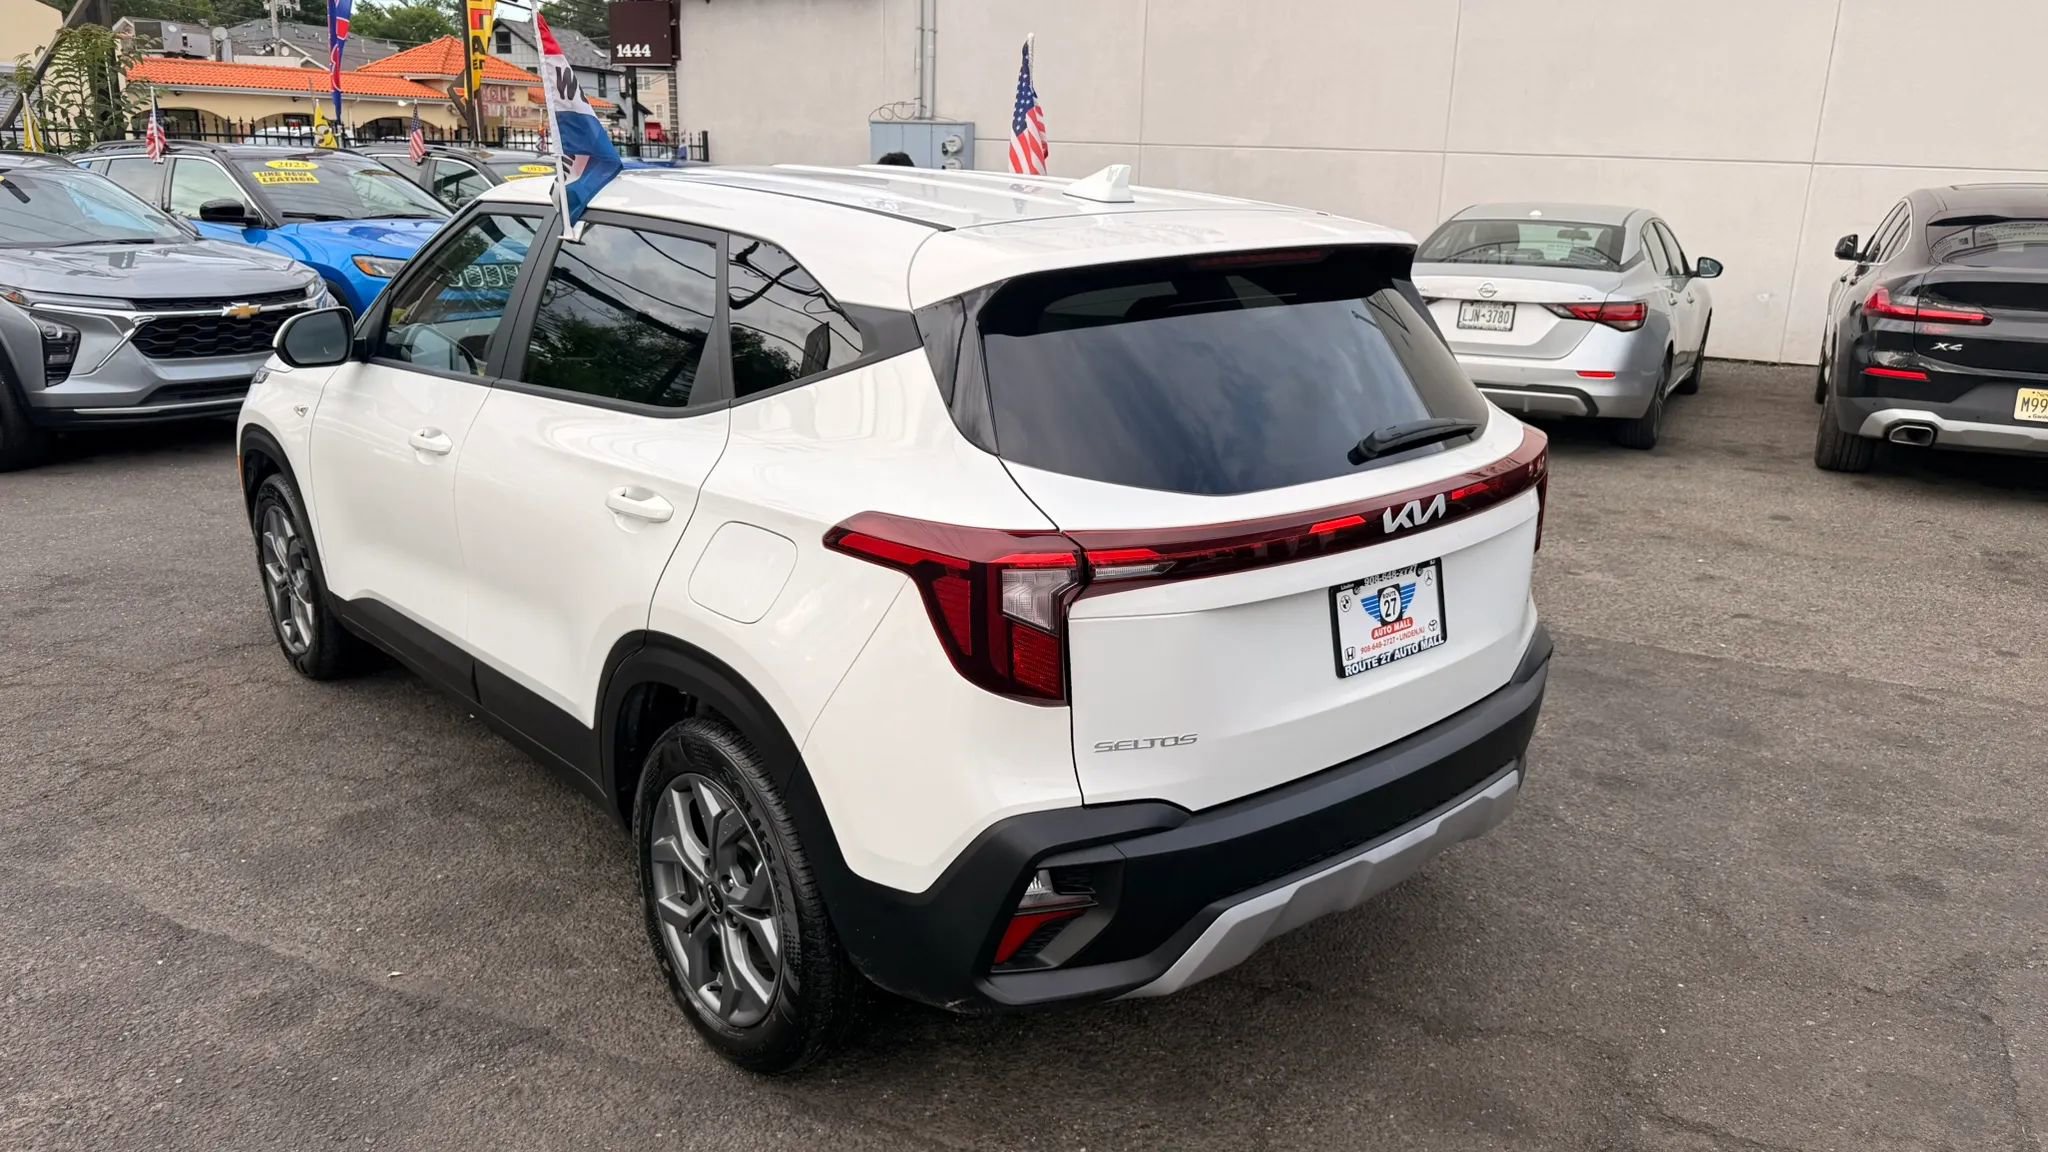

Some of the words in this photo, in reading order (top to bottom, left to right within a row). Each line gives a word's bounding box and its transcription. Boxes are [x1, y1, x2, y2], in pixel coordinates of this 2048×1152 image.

[616, 44, 651, 57] 1444
[1383, 493, 1446, 533] KIA
[1382, 590, 1397, 599] ROUTE
[1383, 597, 1398, 618] 27
[1373, 625, 1393, 637] AUTO
[1393, 618, 1412, 632] MALL
[1360, 636, 1396, 654] 908-648-2727
[1345, 658, 1379, 677] ROUTE
[1380, 652, 1391, 665] 27
[1394, 643, 1419, 660] AUTO
[1420, 634, 1444, 650] MALL
[1094, 733, 1198, 753] SELTOS
